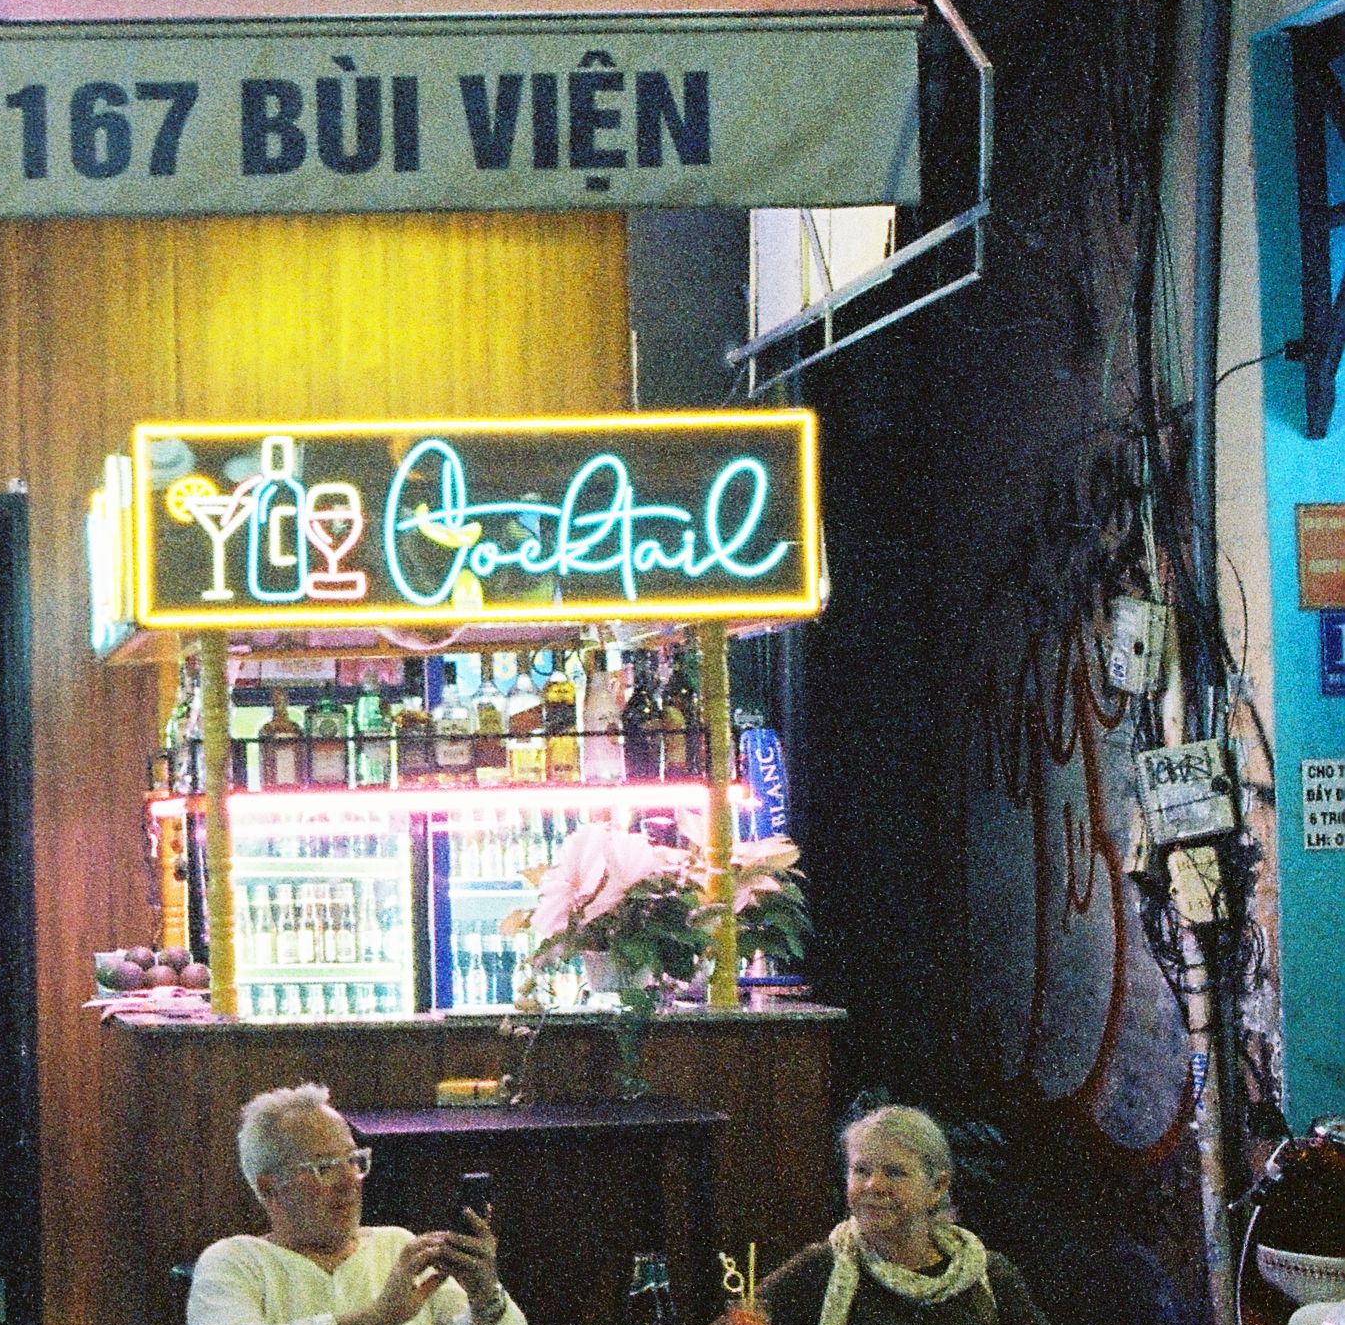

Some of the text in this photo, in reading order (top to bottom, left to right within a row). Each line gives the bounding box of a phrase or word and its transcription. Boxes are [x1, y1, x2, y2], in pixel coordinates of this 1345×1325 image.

[4, 50, 713, 191] 167 BÙI VIỆN
[384, 437, 789, 604] Cocktail
[755, 745, 787, 828] BLANC
[1308, 764, 1335, 778] CHO
